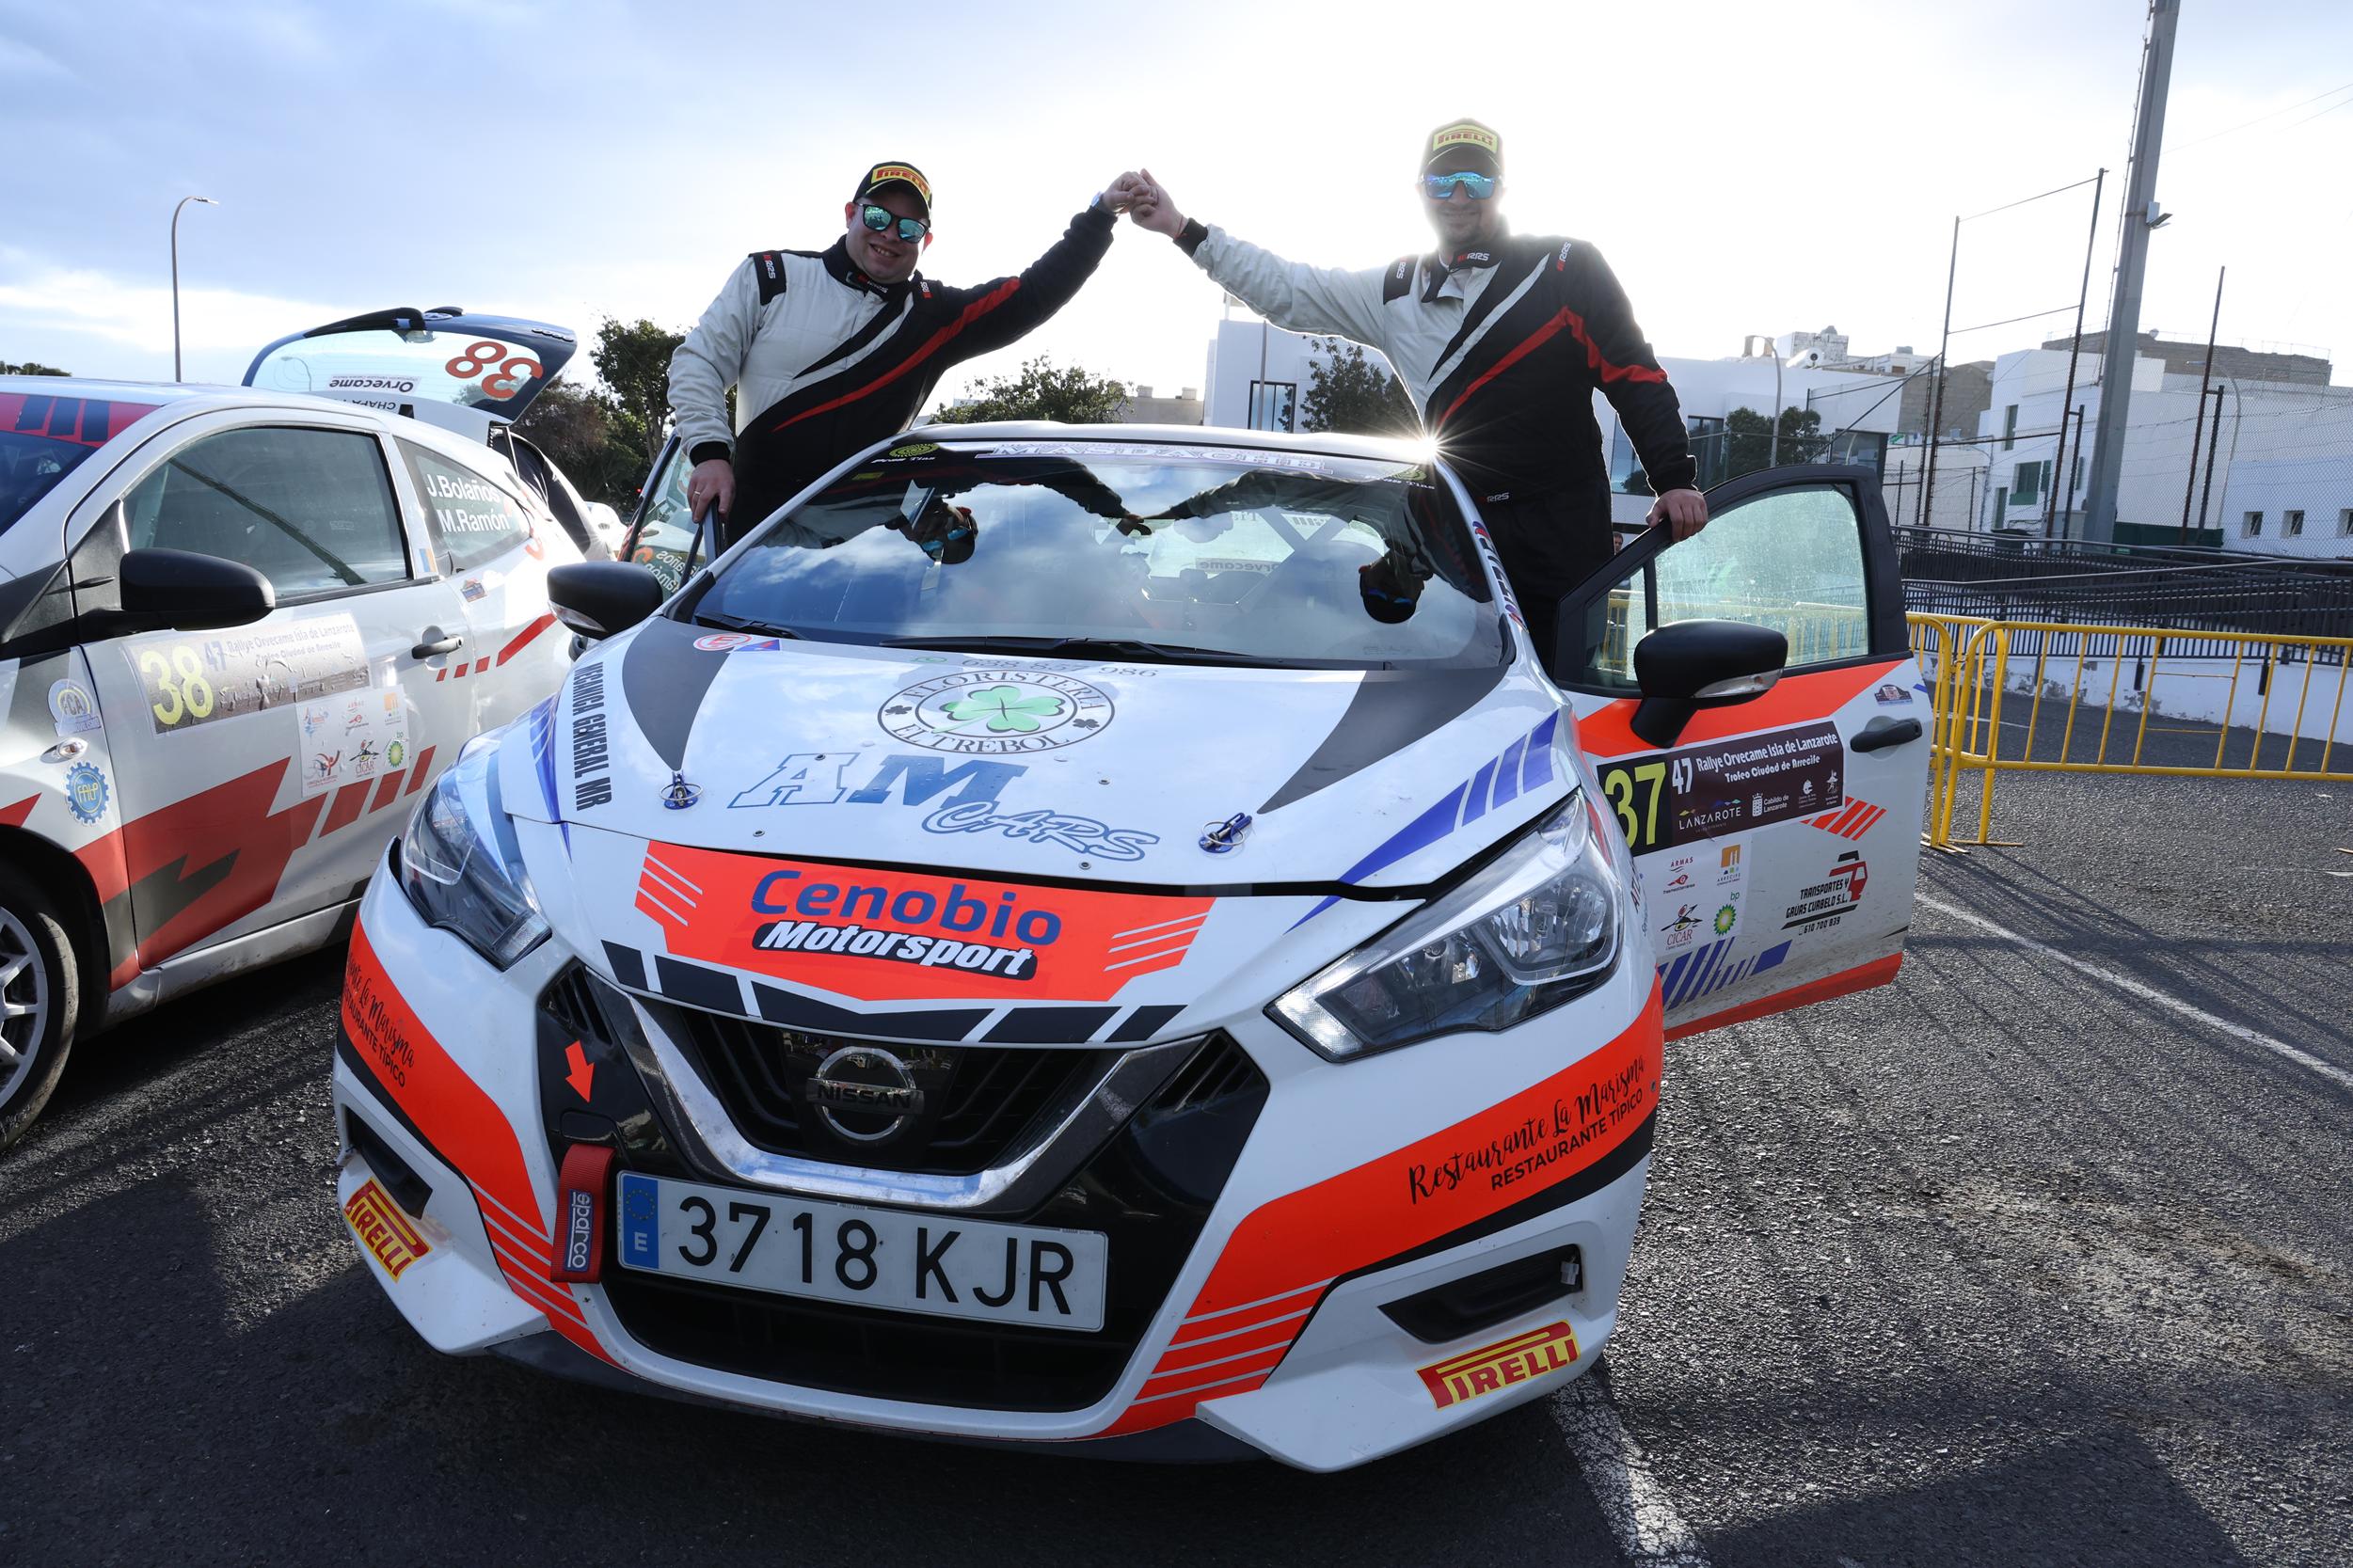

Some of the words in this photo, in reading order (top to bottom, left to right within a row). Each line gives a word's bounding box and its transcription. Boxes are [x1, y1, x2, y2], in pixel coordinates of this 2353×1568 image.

[1438, 128, 1494, 146] PIRELLI
[1467, 252, 1490, 261] RRS
[329, 379, 414, 393] Orvecame
[426, 473, 501, 503] J.Bolaños
[1487, 492, 1510, 503] RRS
[436, 508, 511, 533] M.Ramón
[140, 645, 214, 725] 38
[1098, 666, 1159, 677] 986
[572, 661, 605, 717] MECANICA
[572, 713, 610, 779] GENERAL
[893, 723, 930, 743] EL
[1672, 757, 1693, 795] 47
[1695, 753, 1725, 772] Rallye
[1724, 746, 1768, 768] Orvecame
[1768, 744, 1784, 757] Isla
[1786, 740, 1796, 753] de
[1796, 733, 1838, 751] Lanzarote
[1725, 770, 1751, 784] Trofeo
[1751, 763, 1779, 777] Ciudad
[1781, 760, 1791, 771] de
[1792, 754, 1820, 768] Arrecife
[575, 777, 612, 812] MR
[727, 752, 1029, 813] AM
[1604, 761, 1666, 849] 37
[1763, 796, 1782, 805] Cabildo
[1763, 801, 1788, 813] Lanzarote
[1678, 806, 1741, 831] LANZAROTE
[1670, 856, 1693, 867] ARMAS
[1730, 892, 1741, 902] bp
[1800, 879, 1844, 900] TRANSPORTES
[1807, 895, 1836, 913] CURBELO
[1836, 893, 1848, 905] S.L.
[751, 870, 1062, 946] Cenobio
[760, 921, 1034, 976] Motorsport
[1666, 929, 1693, 945] CICAR
[378, 1042, 405, 1088] TÍPICO
[816, 1084, 912, 1111] NISSAN
[1408, 1117, 1550, 1205] Restaurante
[1552, 1099, 1572, 1137] La
[1574, 1054, 1645, 1125] Marisma
[1490, 1117, 1608, 1191] RESTAURANTE
[1608, 1087, 1644, 1126] TÍPICO
[343, 1180, 430, 1277] PIRELLI
[571, 1193, 591, 1269] sparco
[634, 1231, 648, 1252] E
[678, 1196, 878, 1291] 3718
[914, 1226, 1074, 1315] KJR
[1416, 1320, 1580, 1410] PIRELLI
